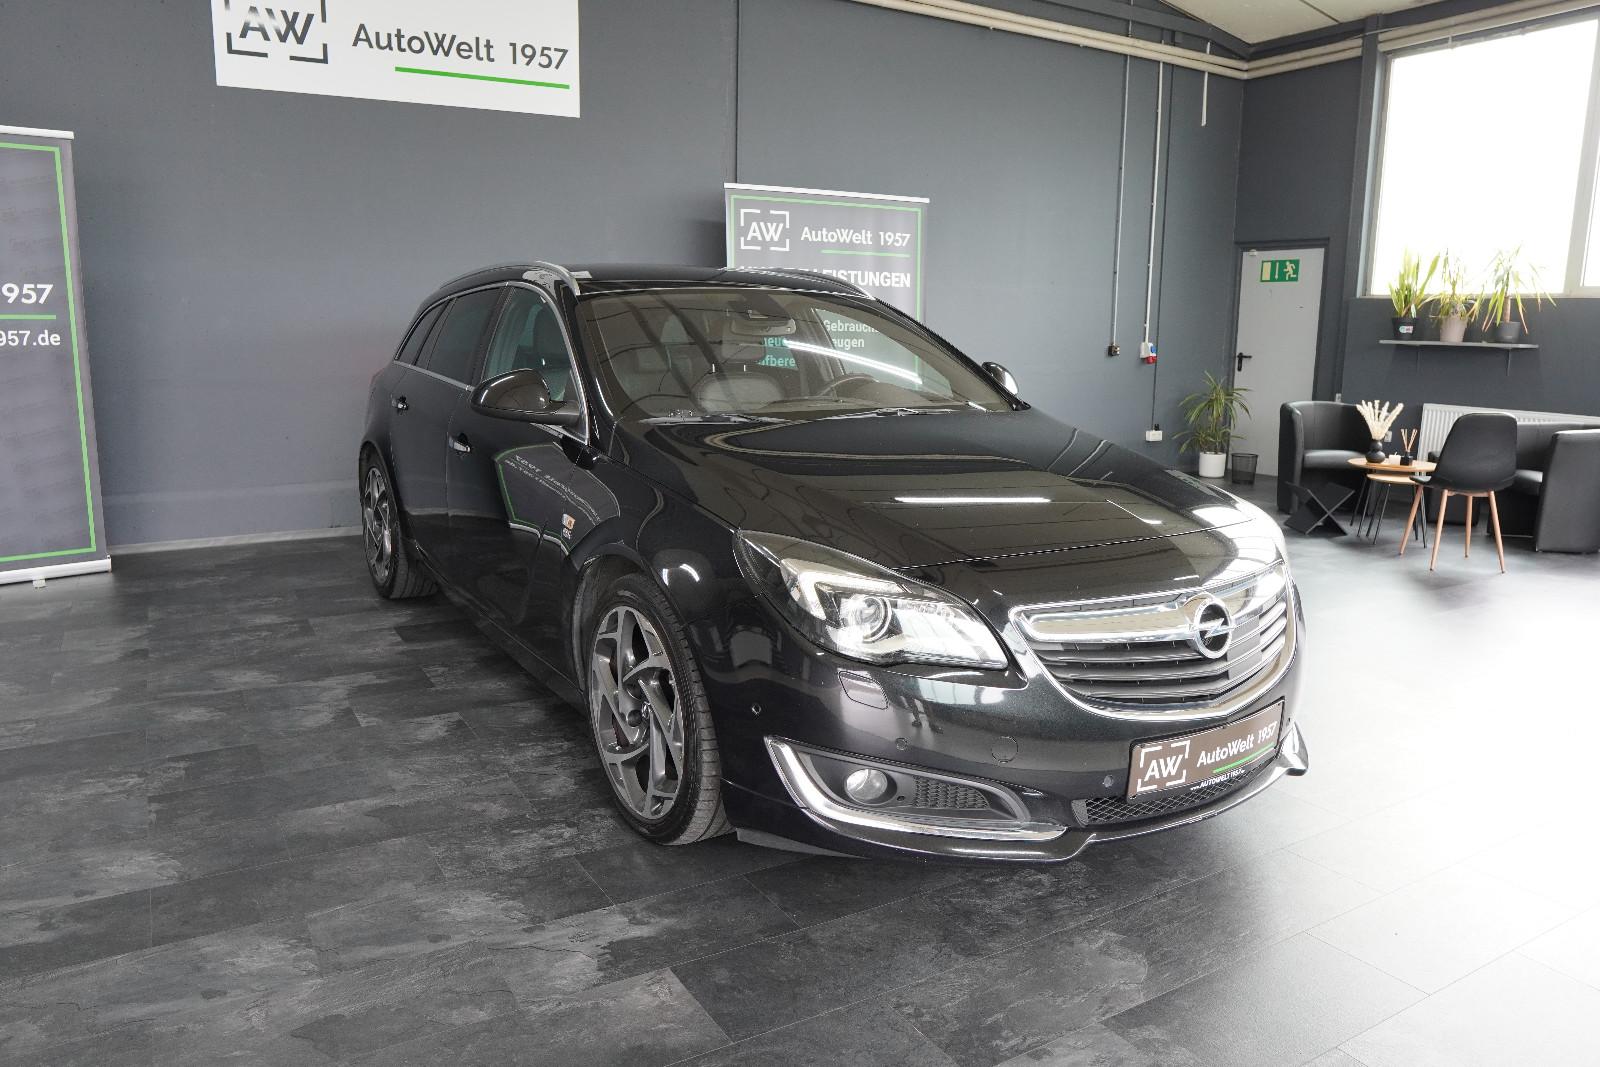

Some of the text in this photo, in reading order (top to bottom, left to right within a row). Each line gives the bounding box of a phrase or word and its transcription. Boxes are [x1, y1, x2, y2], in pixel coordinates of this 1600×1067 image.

[239, 5, 315, 45] AW
[352, 23, 569, 71] AutoWelt 1957
[746, 221, 784, 242] AW
[801, 226, 911, 247] AutoWelt 1957
[812, 268, 911, 288] ISTUNGEN
[1196, 720, 1278, 768] AutoWelt 1957
[1144, 754, 1184, 782] AW
